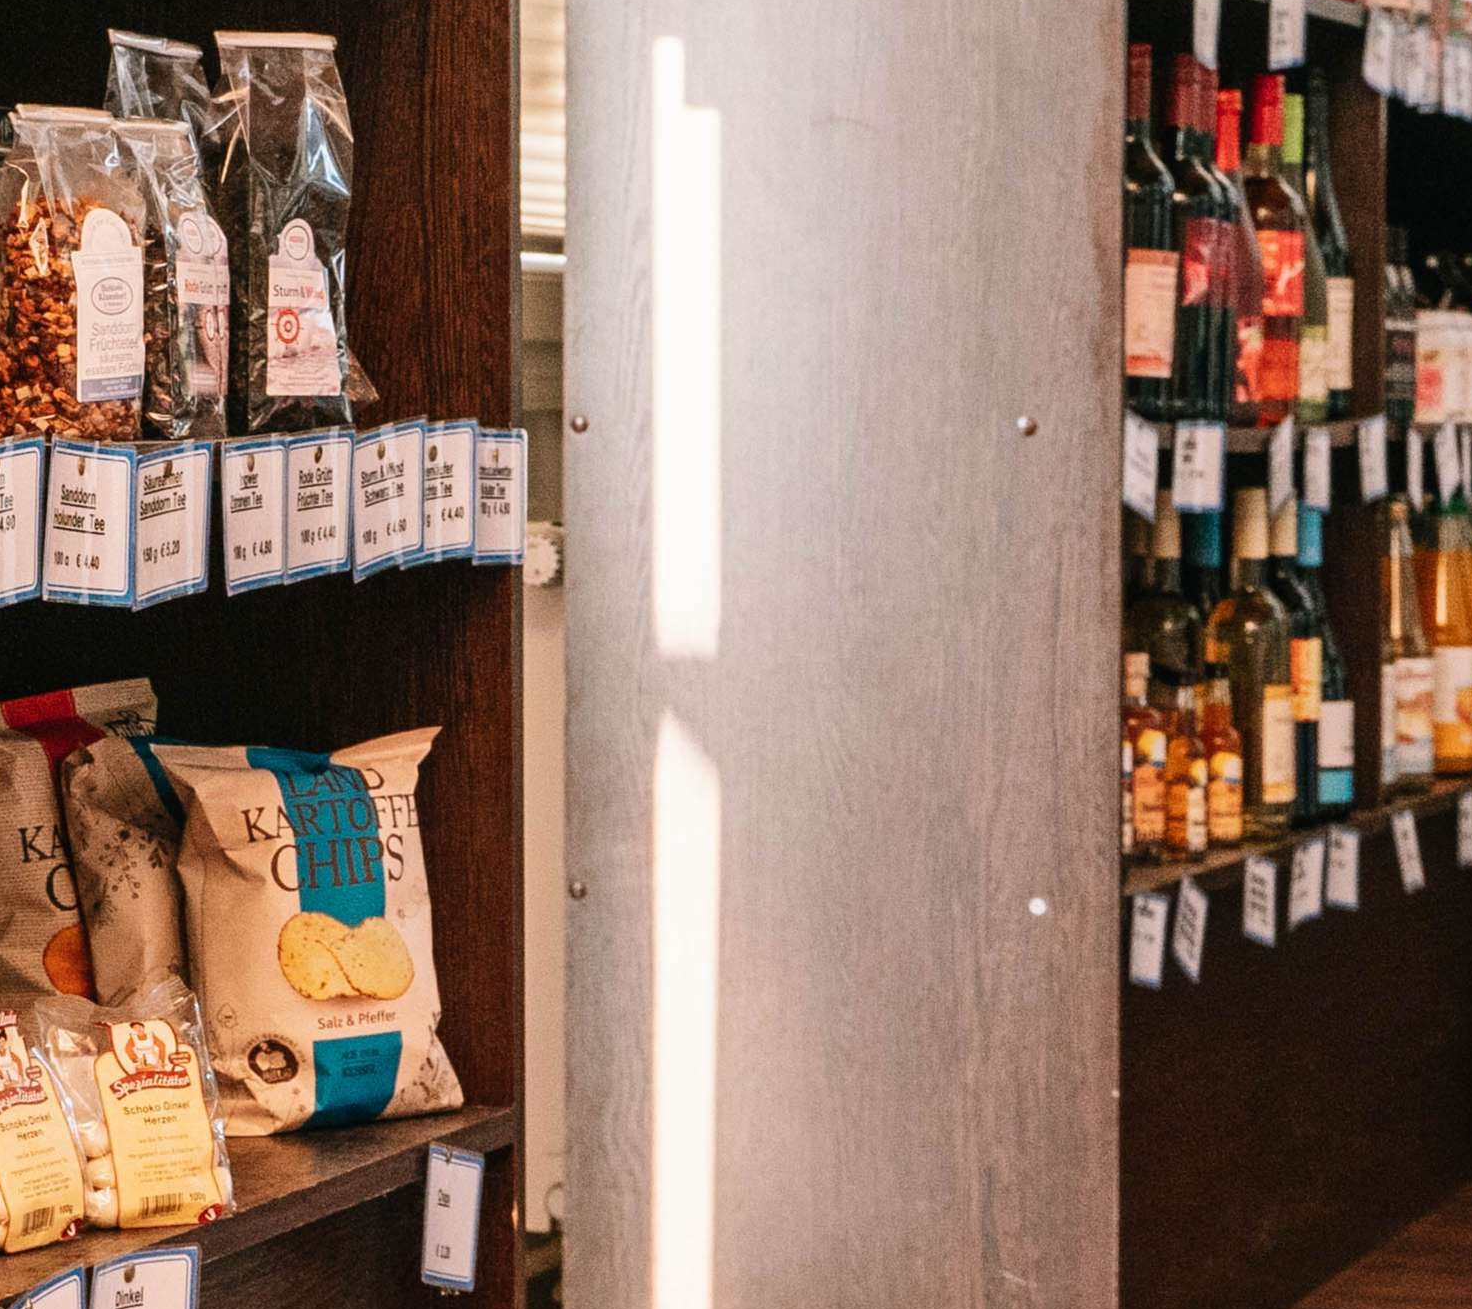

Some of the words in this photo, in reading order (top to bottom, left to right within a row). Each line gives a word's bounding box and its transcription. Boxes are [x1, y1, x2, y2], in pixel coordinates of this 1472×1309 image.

[60, 483, 97, 506] Sanddorn
[240, 792, 420, 844] KARTOFFE
[270, 833, 405, 892] CHIPS
[317, 1016, 344, 1032] Salz
[346, 1014, 355, 1028] &
[357, 1009, 397, 1028] Pfeffer
[112, 1071, 192, 1099] Spezialitäten
[122, 1102, 163, 1117] Schoko
[163, 1099, 192, 1113] Dinkel
[26, 1112, 54, 1128] Dinkel
[142, 1113, 179, 1127] Herzen
[16, 1127, 45, 1142] Herzen
[114, 1286, 145, 1308] Dinkel
